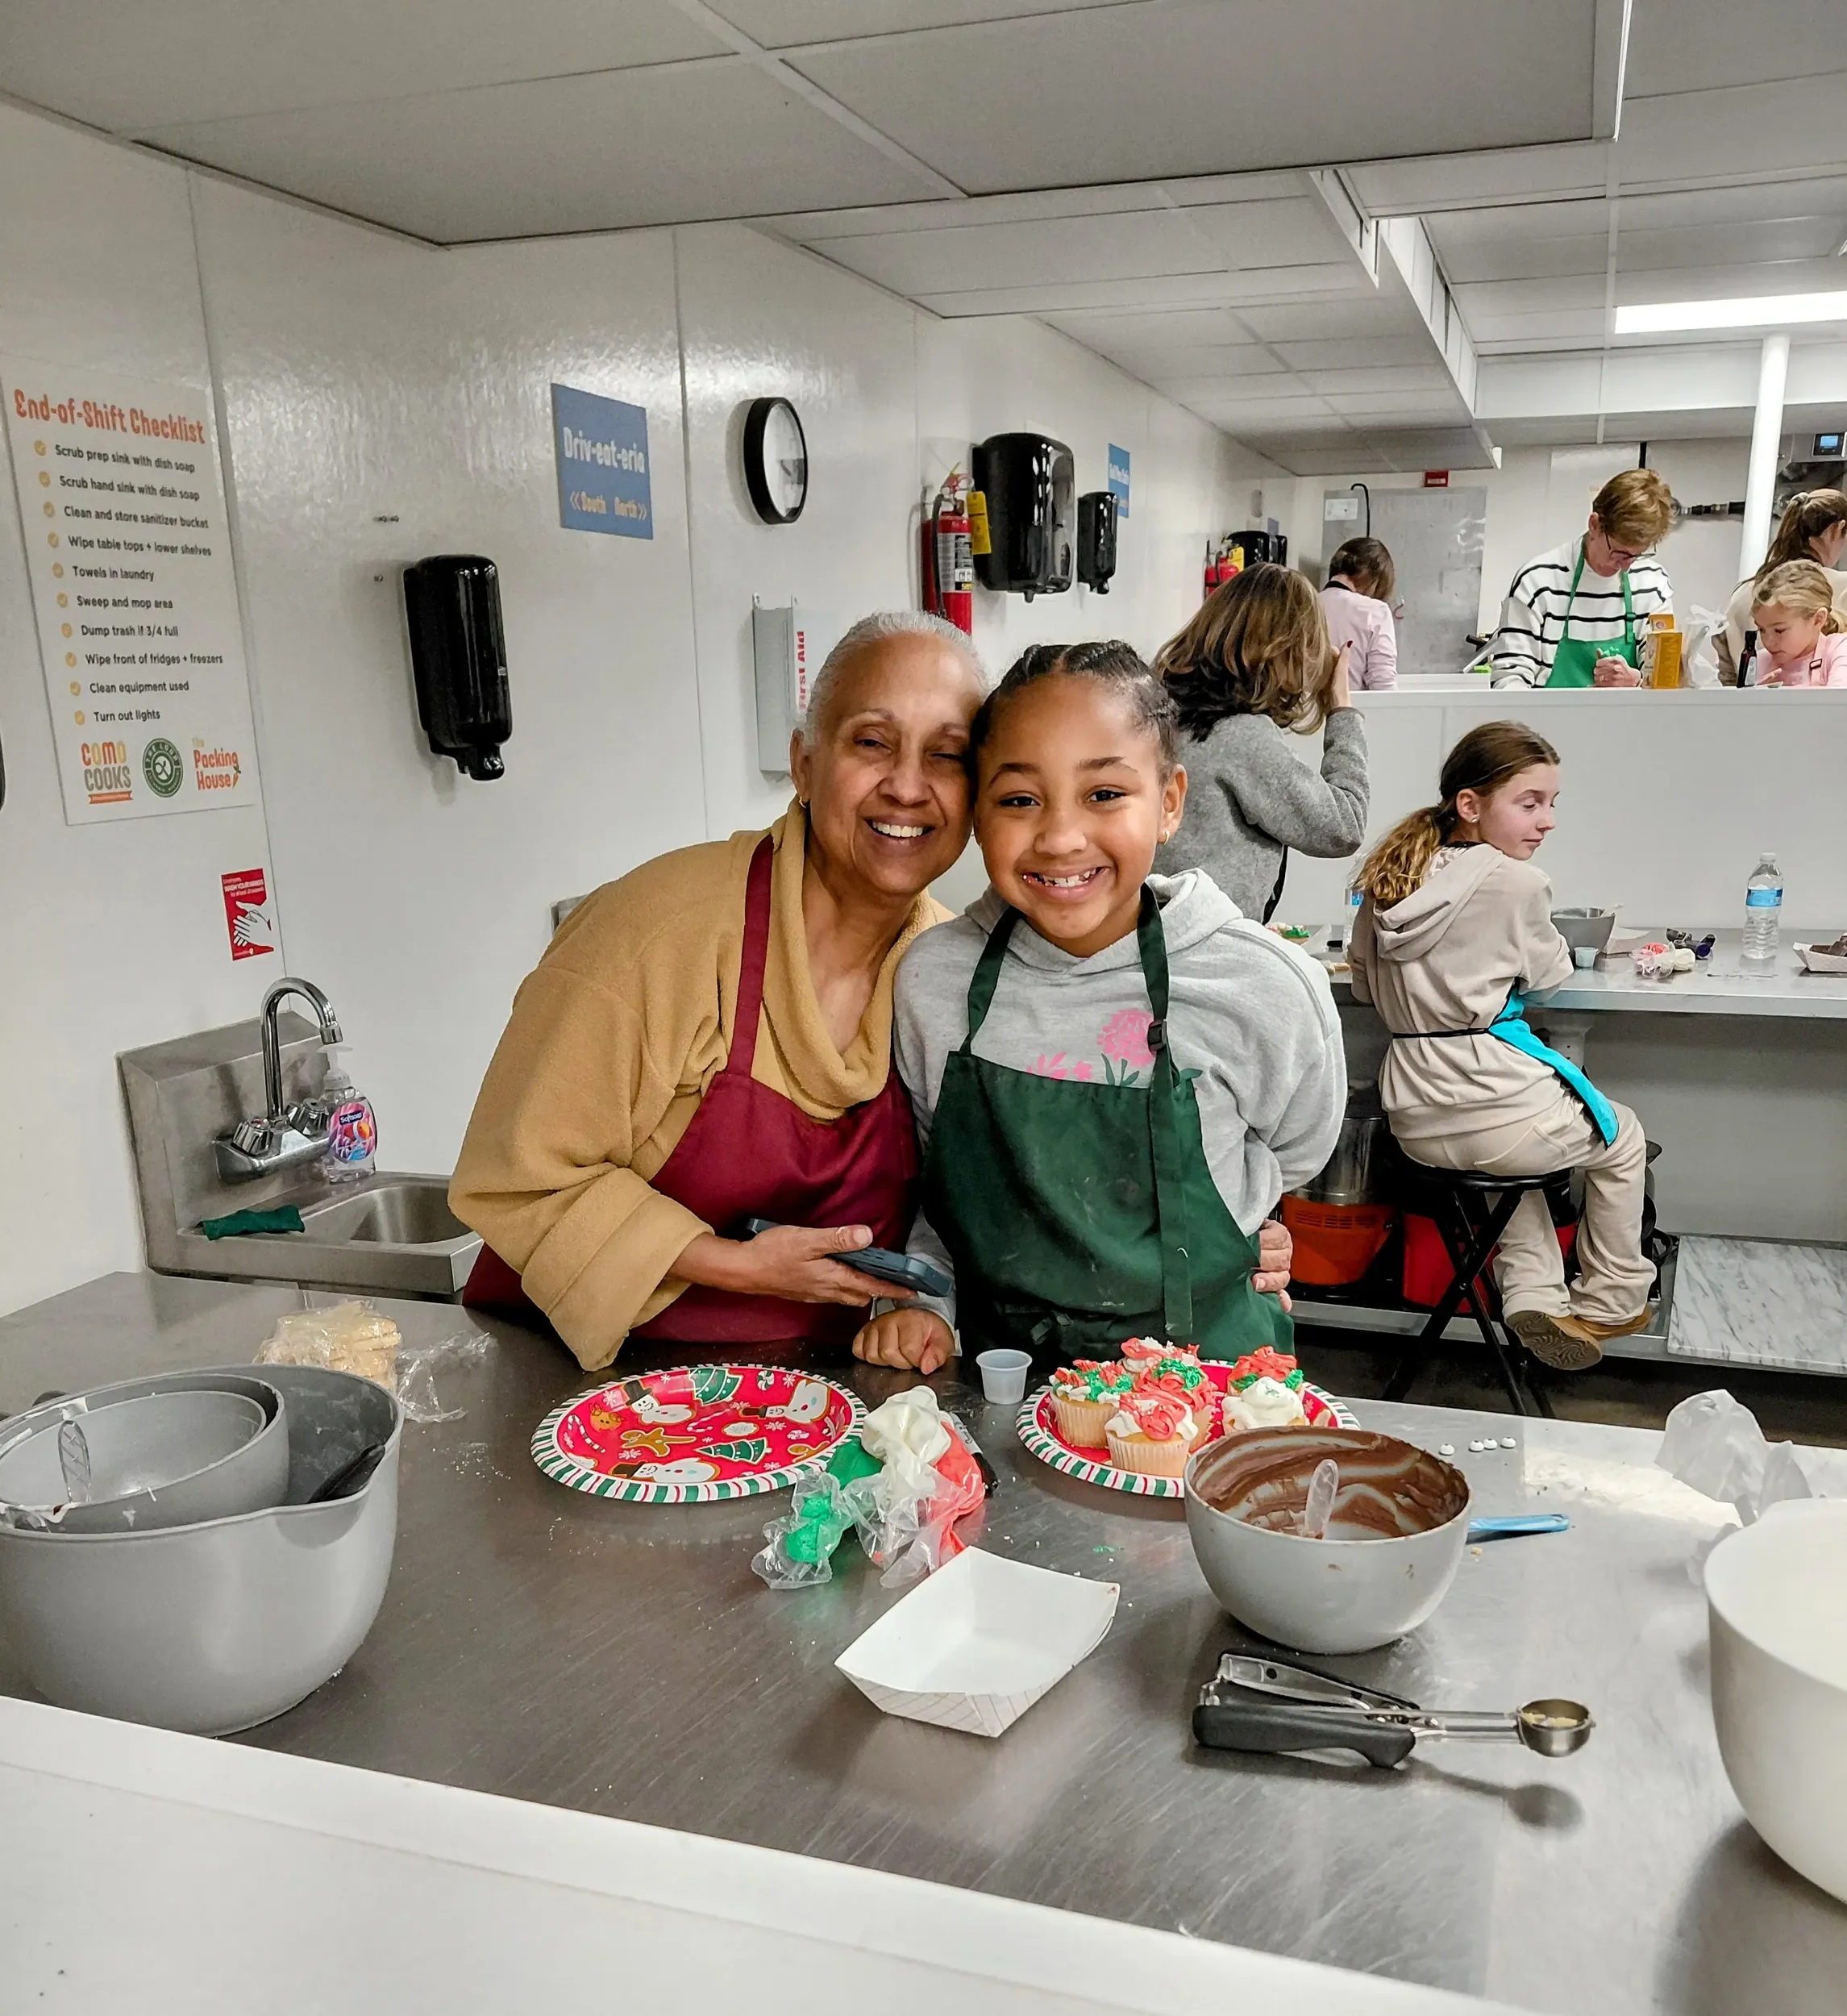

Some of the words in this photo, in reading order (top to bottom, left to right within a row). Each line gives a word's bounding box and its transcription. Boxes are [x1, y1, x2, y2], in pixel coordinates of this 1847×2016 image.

[14, 389, 127, 433] End-of-Shift
[129, 407, 205, 444] Checklist
[55, 444, 84, 459] Scrub
[86, 450, 110, 463] prep
[111, 452, 131, 464] sink
[131, 454, 153, 468] with
[154, 457, 173, 469] dish
[174, 461, 195, 474] soap
[563, 427, 645, 474] Driv-eat-eria
[60, 475, 88, 489] Scrub
[90, 477, 114, 491] hand
[116, 481, 135, 494] sink
[137, 484, 157, 496] with
[159, 485, 177, 498] dish
[178, 489, 200, 502] soap
[64, 505, 92, 519] Clean
[94, 509, 113, 521] and
[114, 511, 139, 523] store
[140, 514, 177, 526] sanitizer
[179, 514, 210, 528] bucket
[68, 535, 94, 550] Wipe
[97, 537, 121, 550] table
[123, 539, 144, 552] tops
[153, 541, 178, 554] lower
[180, 544, 211, 556] shelves
[72, 565, 107, 578] Towels
[108, 566, 119, 578] in
[119, 568, 155, 582] laundry
[77, 595, 109, 609] Sweep
[111, 595, 129, 608] and
[131, 599, 152, 610] mop
[154, 600, 173, 609] area
[81, 624, 110, 638] Dump
[111, 625, 135, 636] trash
[137, 624, 144, 637] if
[146, 623, 162, 638] 3/4
[164, 625, 179, 636] full
[85, 653, 110, 667] Wipe
[113, 653, 136, 664] front
[138, 653, 148, 664] of
[149, 653, 181, 666] fridges
[189, 653, 223, 664] freezers
[89, 682, 117, 694] Clean
[119, 681, 168, 694] equipment
[168, 680, 189, 691] used
[93, 710, 115, 723] Turn
[118, 710, 134, 722] out
[135, 709, 160, 723] lights
[193, 747, 239, 769] Packing
[84, 765, 132, 792] COOKS
[196, 770, 231, 791] House
